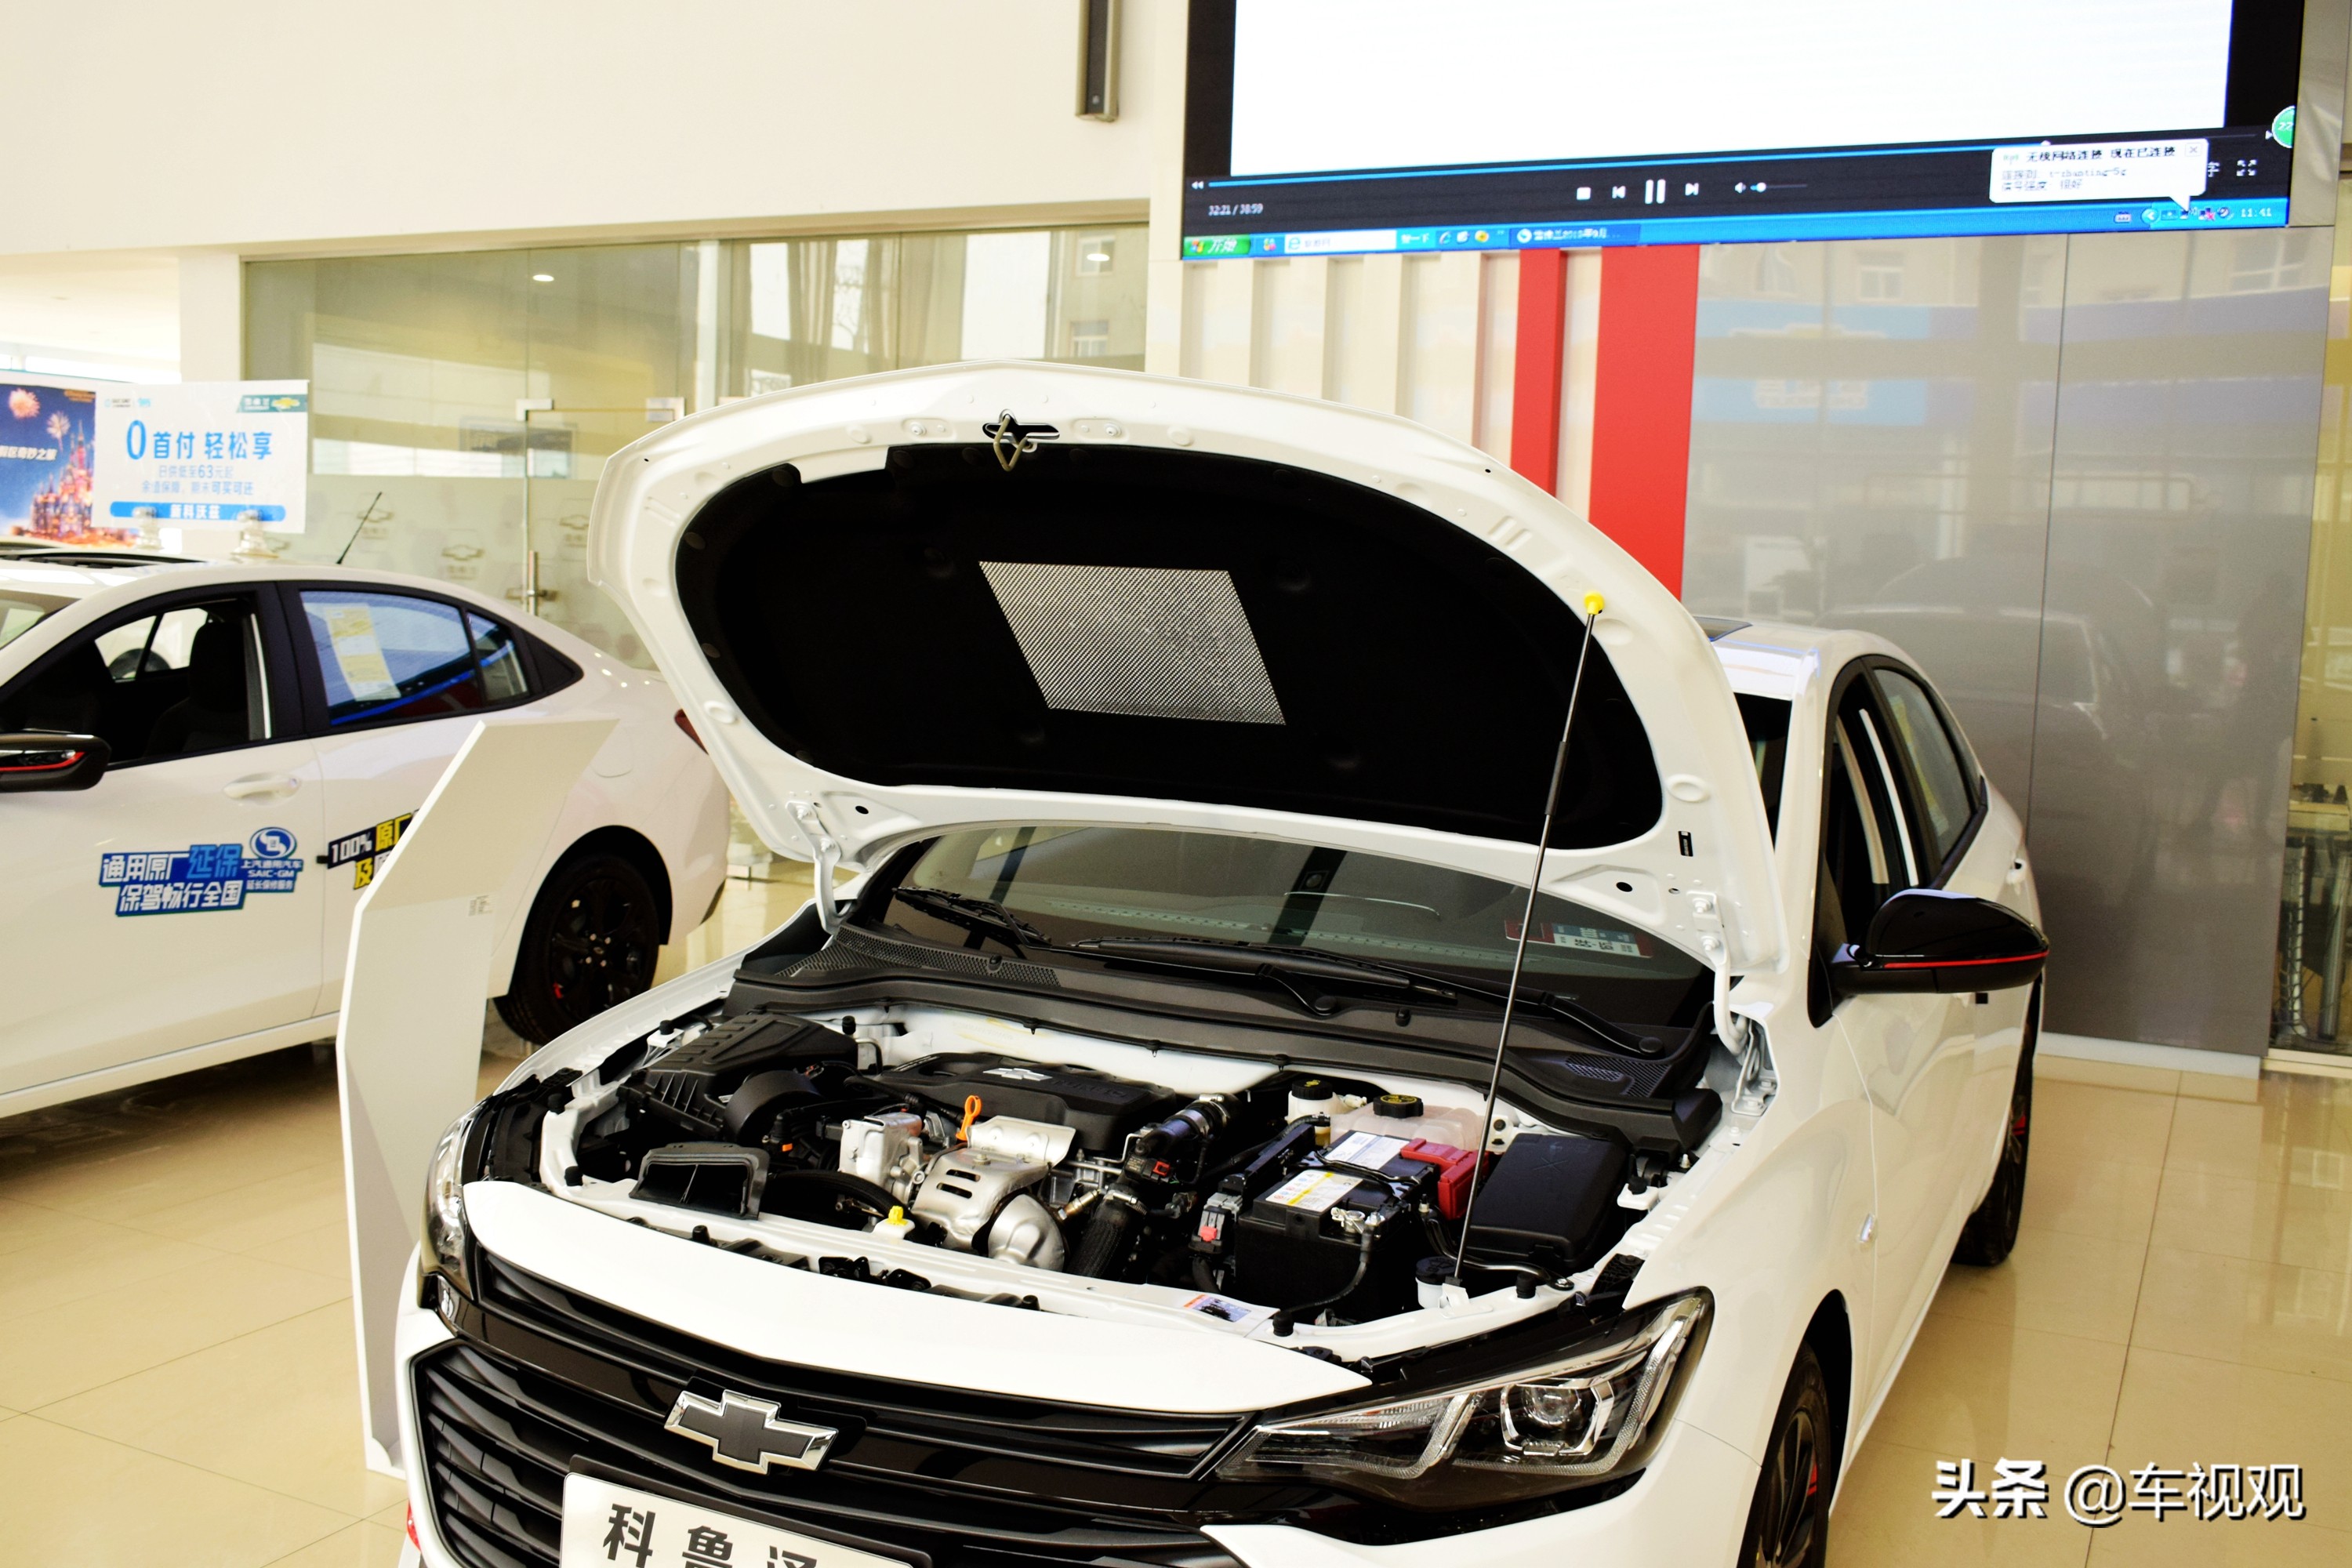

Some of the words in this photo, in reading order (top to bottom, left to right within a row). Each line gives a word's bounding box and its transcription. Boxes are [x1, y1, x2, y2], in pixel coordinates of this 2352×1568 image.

[2241, 207, 2272, 217] 11:41
[205, 431, 272, 460] 轻松享
[240, 859, 303, 869] 上汽通用汽车
[248, 869, 295, 878] SAIC-GM
[119, 880, 242, 912] 保驾畅行全国
